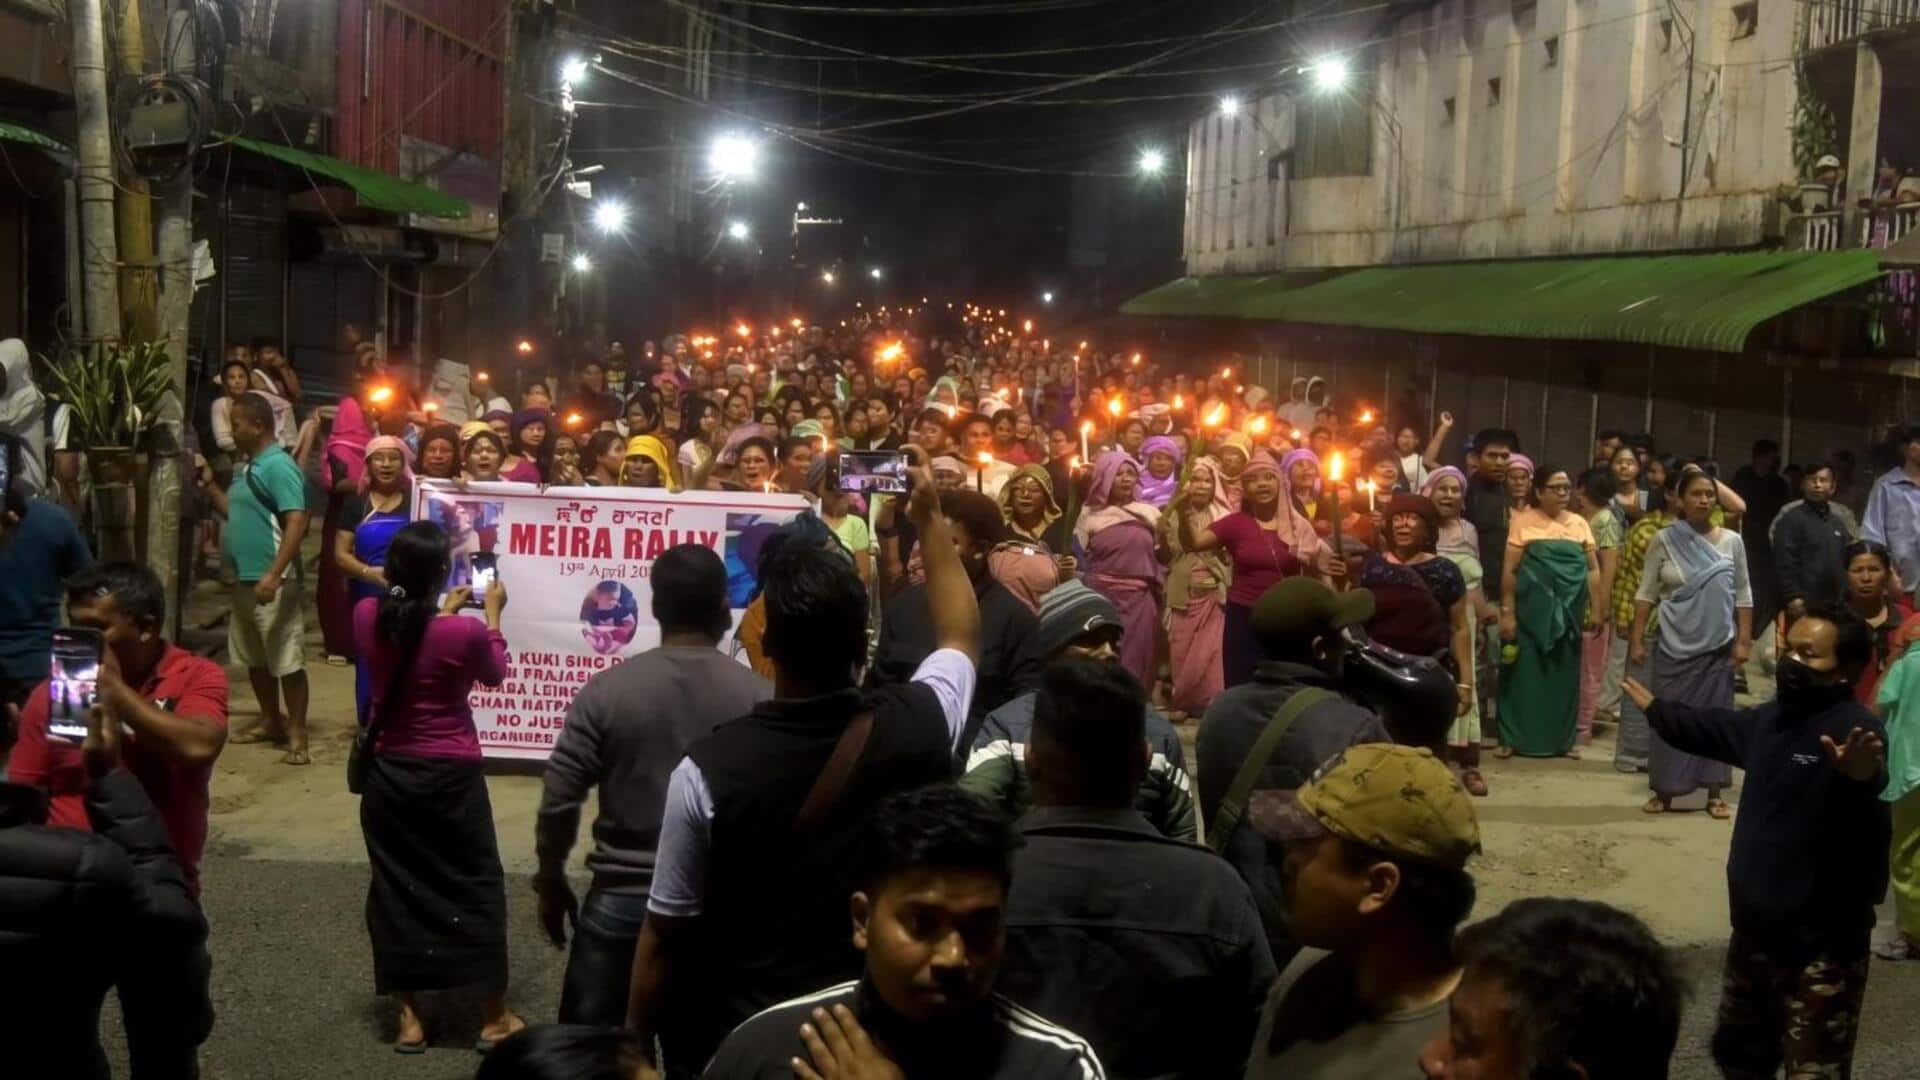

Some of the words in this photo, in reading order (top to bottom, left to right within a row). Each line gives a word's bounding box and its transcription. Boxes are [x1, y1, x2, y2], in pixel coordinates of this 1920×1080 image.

[510, 523, 613, 559] MEIRA
[589, 564, 626, 580] April
[630, 565, 652, 580] 20
[519, 652, 560, 668] KUKI
[496, 713, 521, 728] NO
[527, 715, 567, 730] JUS
